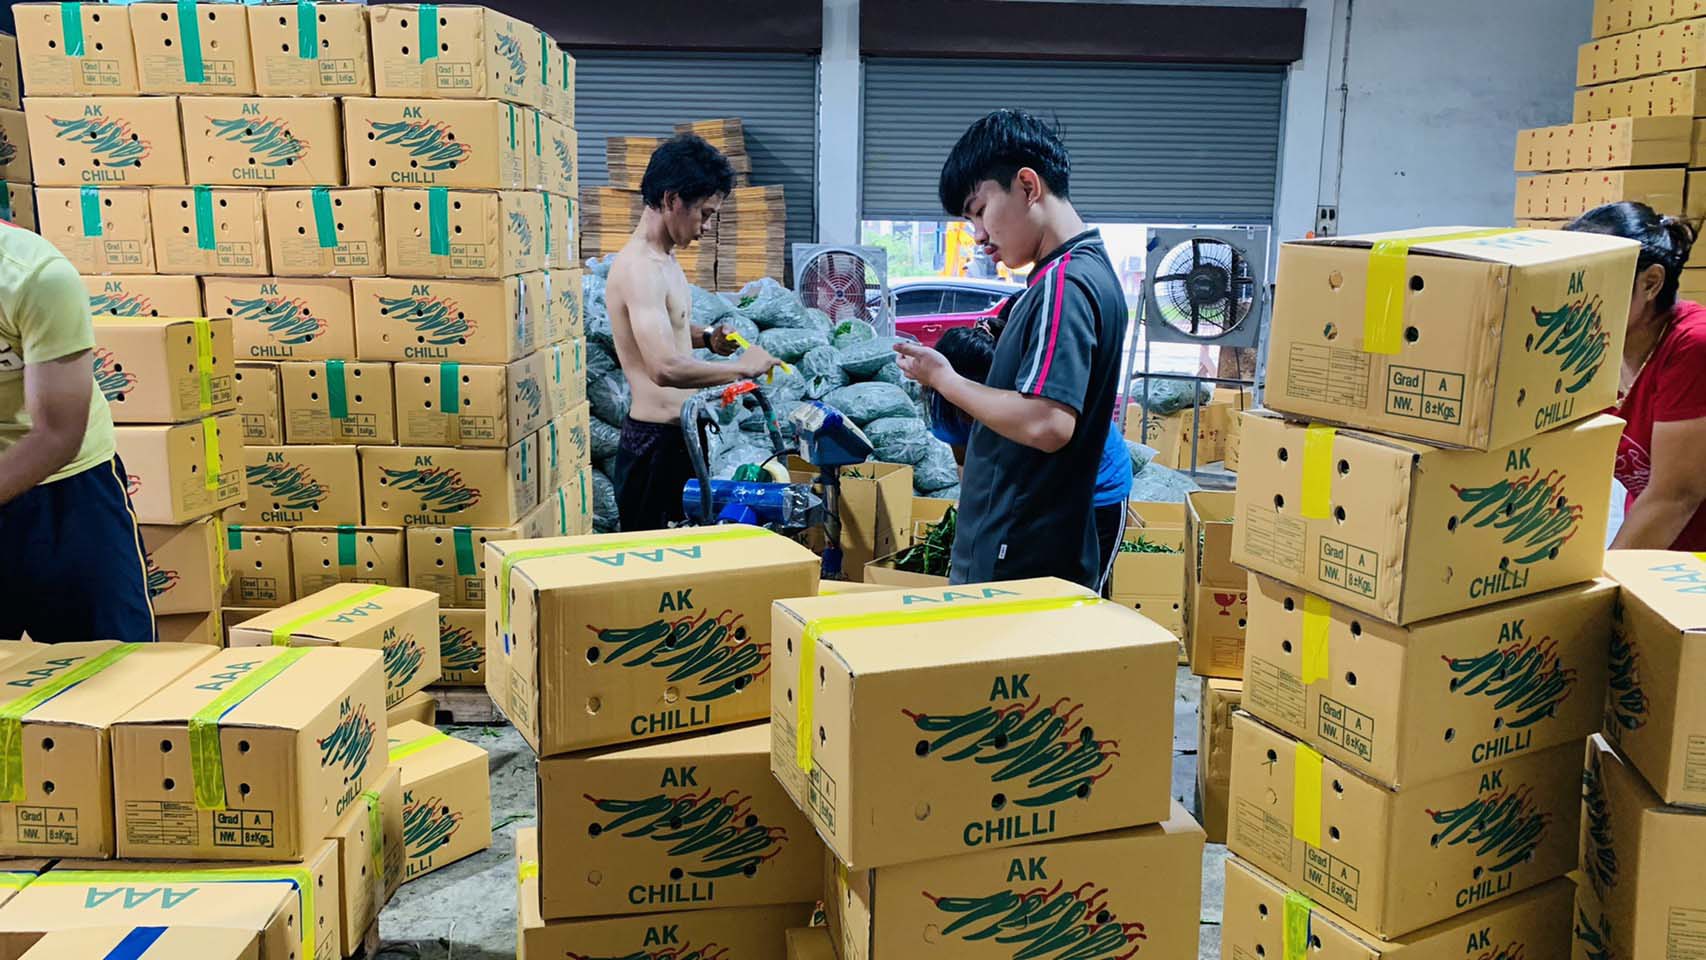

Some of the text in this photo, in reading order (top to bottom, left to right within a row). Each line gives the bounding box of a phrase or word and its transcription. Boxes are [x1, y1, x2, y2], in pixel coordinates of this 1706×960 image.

[84, 106, 103, 116] AK
[242, 104, 260, 114] AK
[402, 106, 423, 118] AK
[82, 170, 126, 182] CHILLI
[232, 168, 276, 180] CHILLI
[391, 172, 435, 184] CHILLI
[104, 282, 123, 292] AK
[260, 284, 279, 295] AK
[411, 284, 430, 296] AK
[1567, 271, 1585, 296] AK
[250, 346, 293, 357] CHILLI
[404, 346, 448, 358] CHILLI
[1393, 372, 1448, 392] Grad A
[1393, 396, 1414, 412] NW.
[1534, 397, 1574, 430] CHILLI
[266, 452, 284, 462] AK
[415, 456, 433, 466] AK
[1505, 448, 1532, 472] AK
[261, 511, 304, 522] CHILLI
[404, 514, 446, 526] CHILLI
[589, 546, 701, 566] AAA
[1323, 542, 1366, 567] Grad A
[1324, 565, 1341, 582] NW.
[1470, 568, 1529, 599] CHILLI
[658, 588, 694, 613] AK
[902, 588, 1022, 606] AAA
[328, 601, 382, 623] AAA
[384, 626, 396, 642] AK
[1498, 619, 1524, 644] AK
[6, 656, 86, 688] AAA
[195, 660, 262, 691] AAA
[990, 674, 1030, 701] AK
[340, 696, 352, 718] AK
[1322, 702, 1362, 730] Grad A
[630, 704, 711, 736] CHILLI
[1322, 722, 1339, 740] NW.
[1471, 730, 1530, 764] CHILLI
[660, 766, 698, 788] AK
[1479, 769, 1504, 793] AK
[336, 779, 362, 816] CHILLI
[20, 811, 65, 822] Grad A
[218, 814, 261, 825] Grad A
[219, 831, 236, 842] NW.
[964, 810, 1056, 846] CHILLI
[1006, 856, 1048, 882] AK
[1308, 849, 1348, 880] Grad A
[1308, 868, 1324, 887] NW.
[84, 887, 200, 909] AAA
[628, 882, 714, 906] CHILLI
[1456, 872, 1512, 908] CHILLI
[642, 925, 679, 947] AK
[1466, 928, 1491, 953] AK
